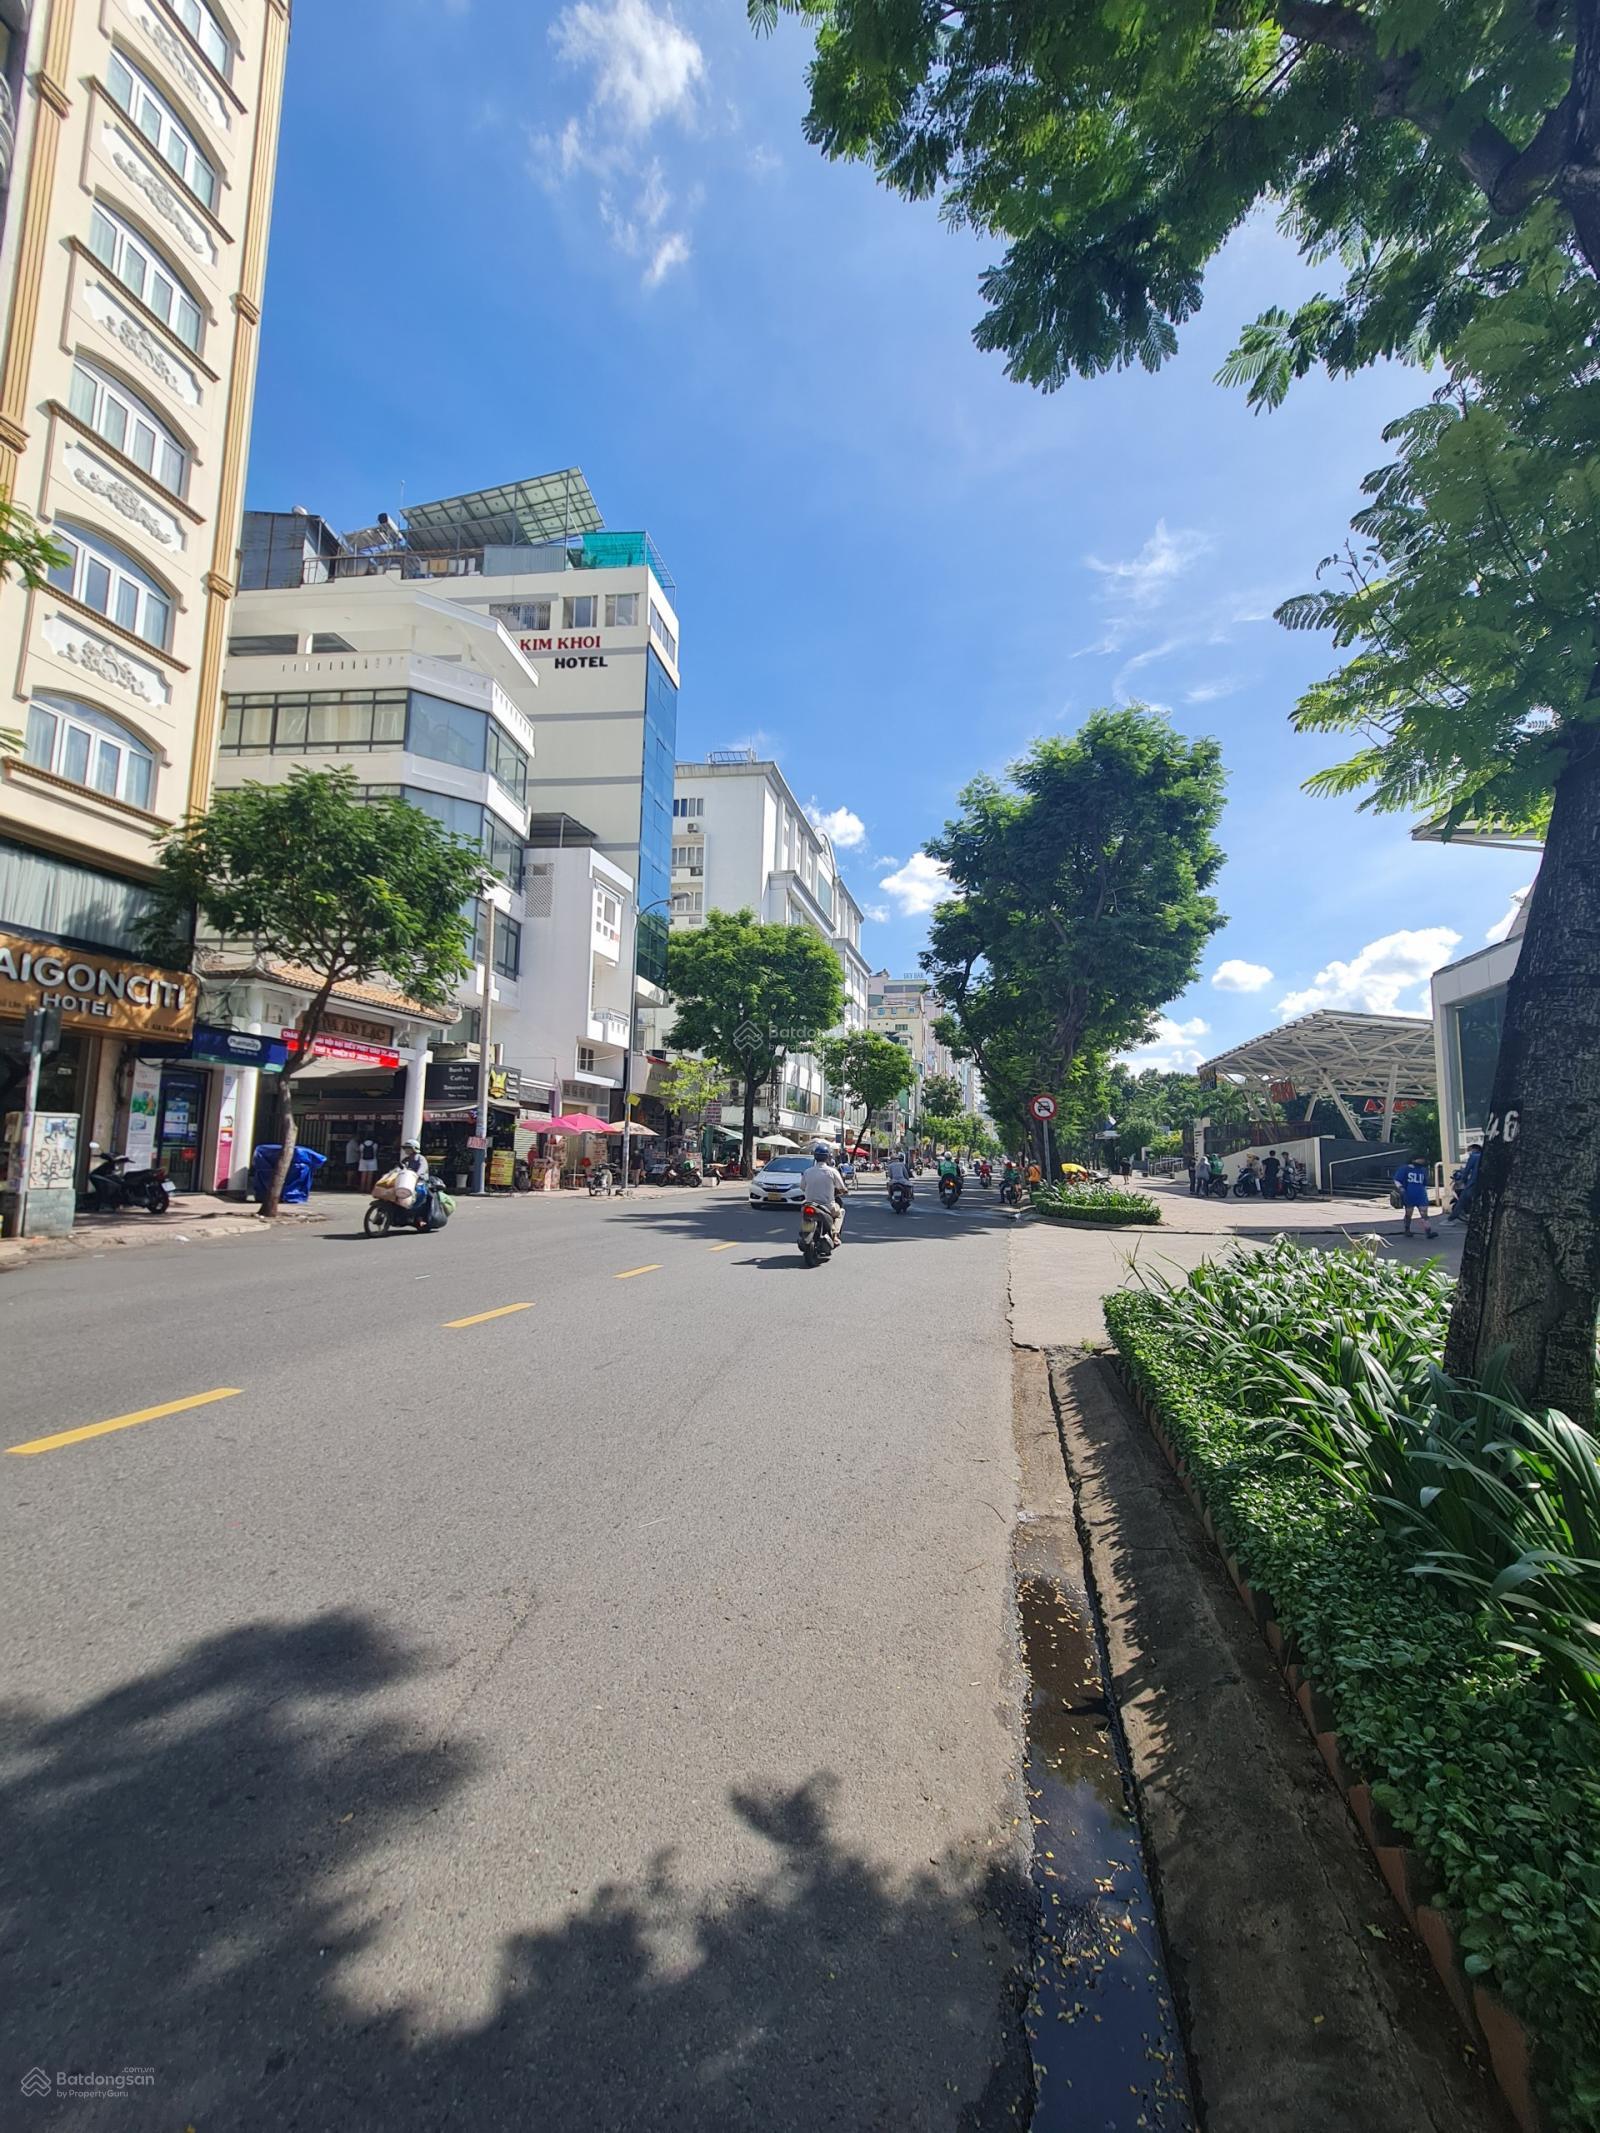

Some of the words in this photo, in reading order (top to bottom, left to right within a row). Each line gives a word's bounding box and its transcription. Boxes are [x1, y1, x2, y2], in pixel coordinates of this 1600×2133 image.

[519, 638, 553, 651] KIM
[557, 635, 601, 650] KHOI
[554, 656, 608, 669] HOTEL
[42, 992, 114, 1017] HOTEL
[1485, 1110, 1520, 1143] 46
